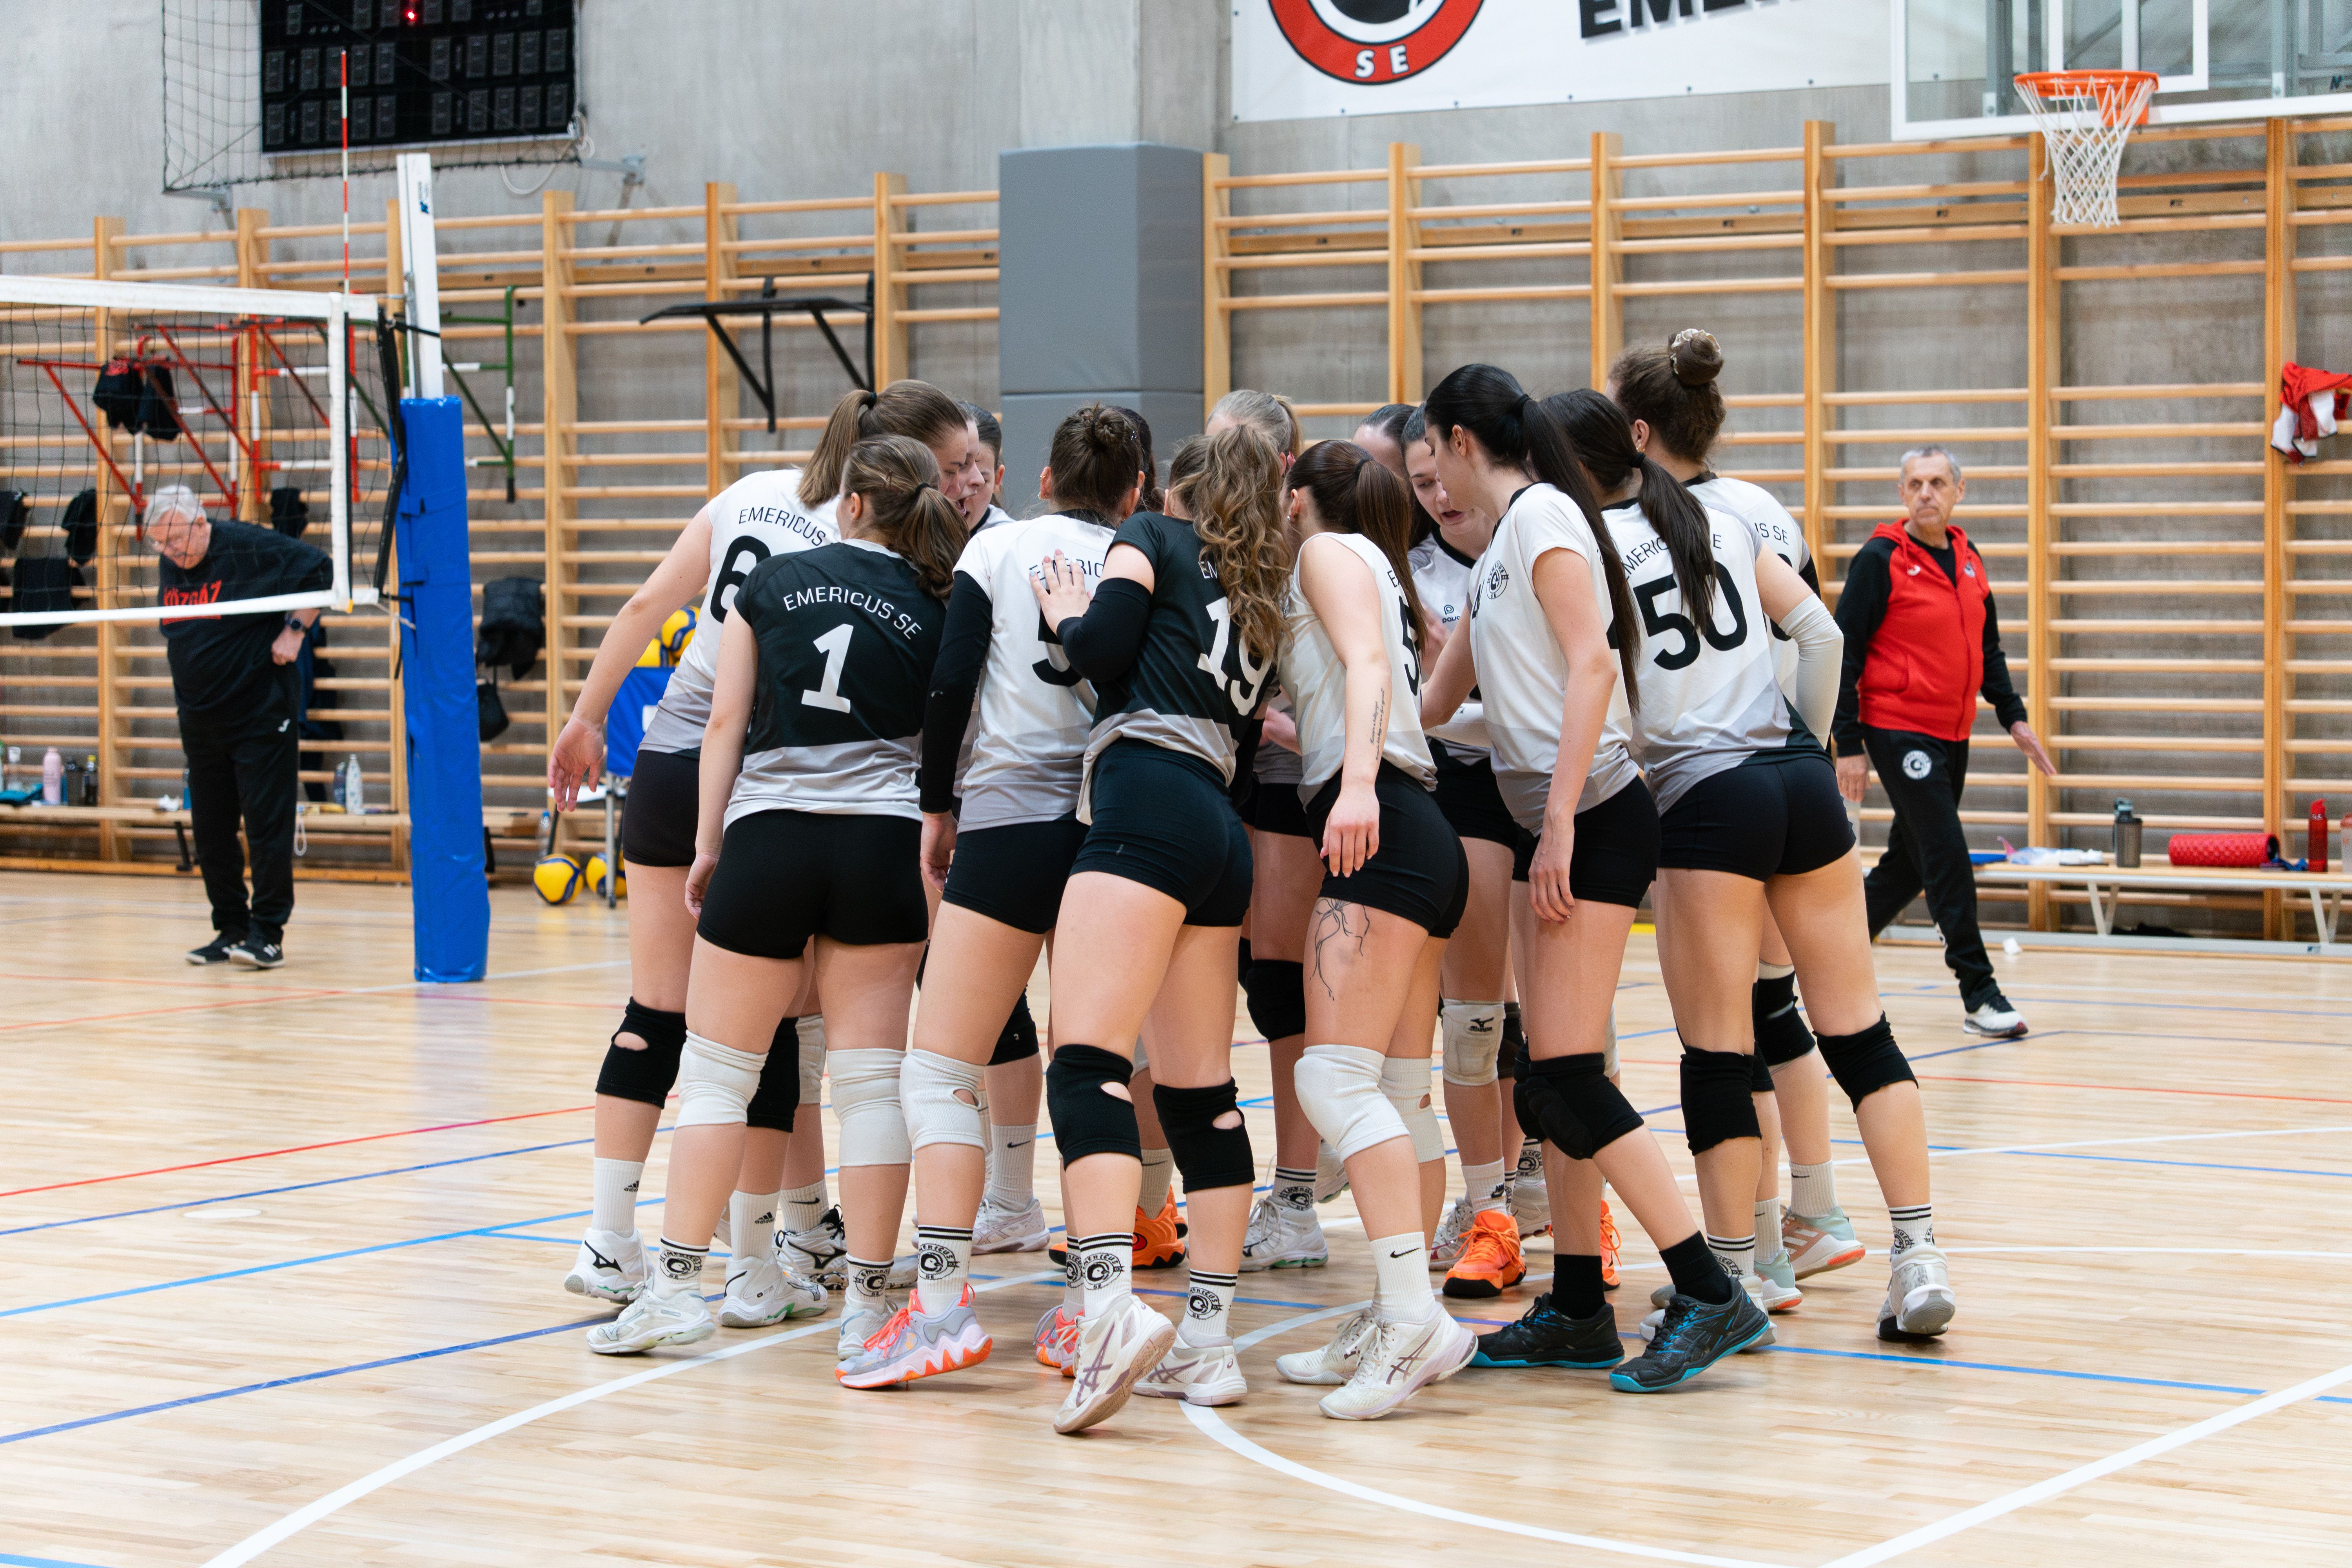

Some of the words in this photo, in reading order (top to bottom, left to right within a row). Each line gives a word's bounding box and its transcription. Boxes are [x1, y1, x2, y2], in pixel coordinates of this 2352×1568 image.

[1354, 44, 1410, 78] SE
[738, 507, 826, 546] EMERICUS
[1773, 525, 1789, 545] SE
[1623, 537, 1669, 581] MERIC
[783, 586, 895, 619] EMERICUS
[893, 613, 922, 639] SE
[1633, 561, 1748, 671] 50
[801, 624, 854, 713] 1
[1197, 596, 1273, 716] 19
